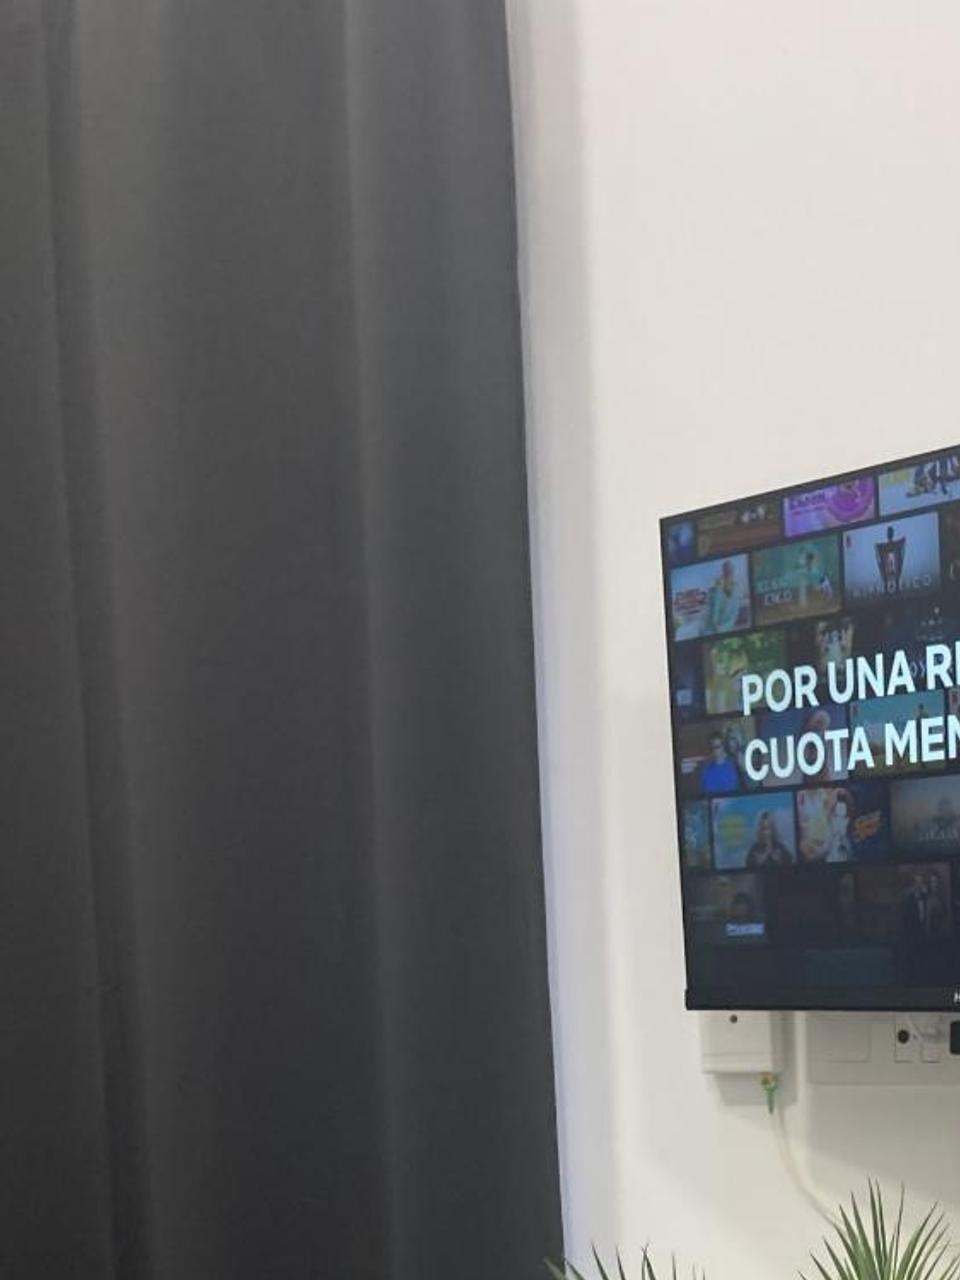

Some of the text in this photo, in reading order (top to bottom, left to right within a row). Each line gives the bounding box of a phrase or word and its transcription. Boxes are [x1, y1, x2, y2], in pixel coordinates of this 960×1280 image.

[741, 664, 819, 717] POR
[826, 650, 917, 705] UNA
[744, 718, 876, 782] CUOTA
